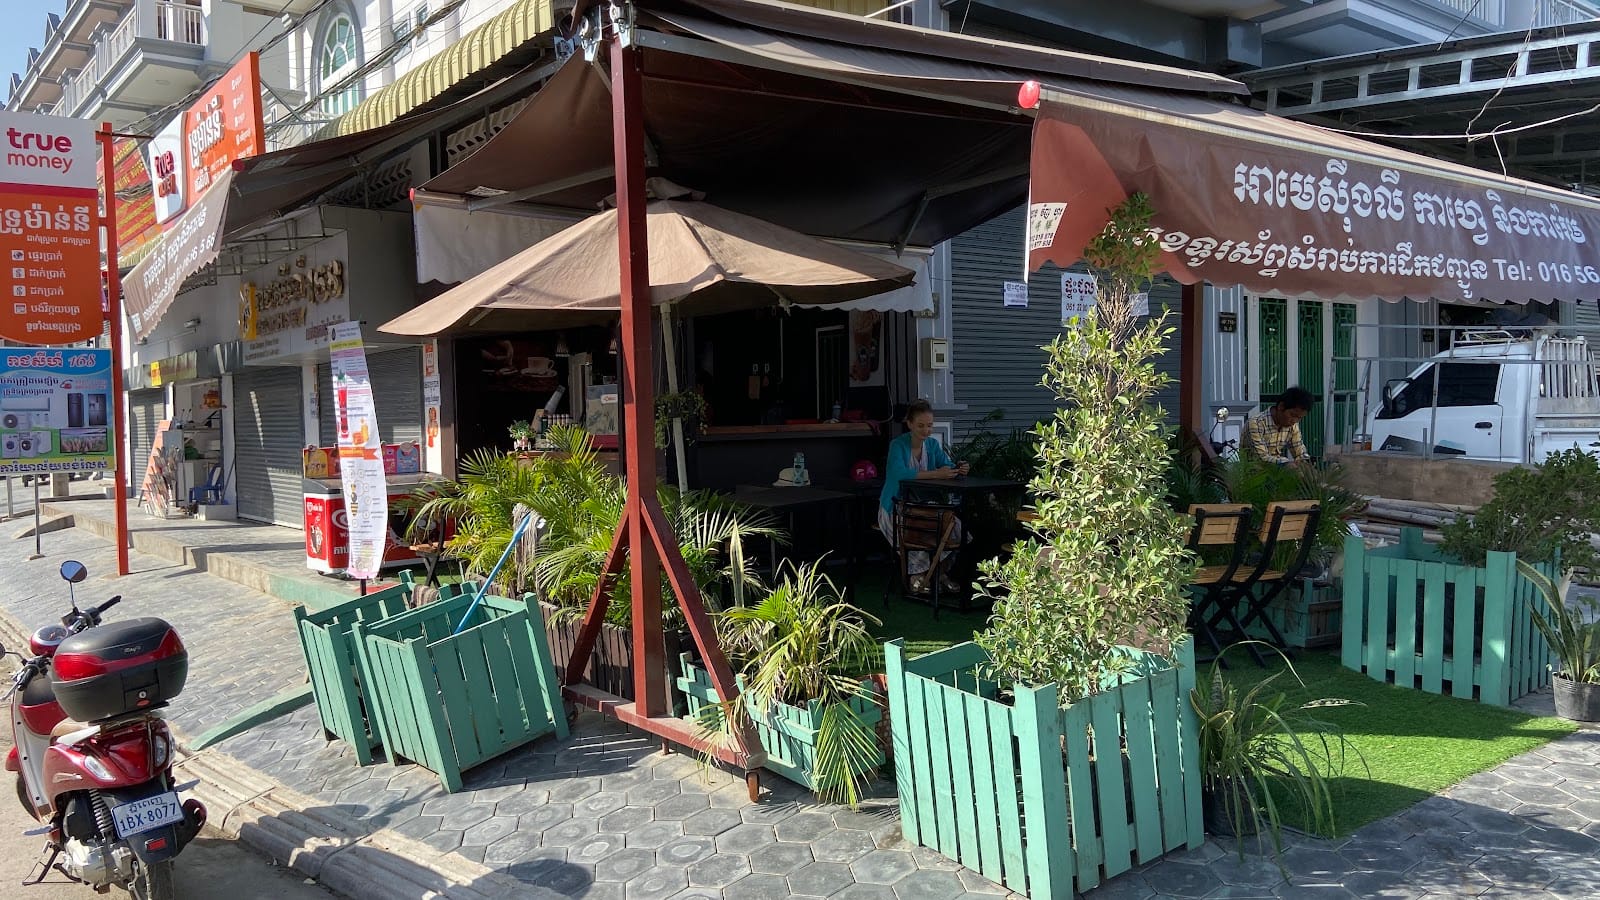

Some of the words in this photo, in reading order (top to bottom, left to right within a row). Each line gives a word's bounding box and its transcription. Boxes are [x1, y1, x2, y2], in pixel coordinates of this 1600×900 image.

[7, 127, 73, 153] true
[7, 152, 73, 174] money
[1493, 259, 1533, 282] Tel:
[1538, 261, 1572, 284] 016
[120, 803, 176, 832] 1BX-8077
